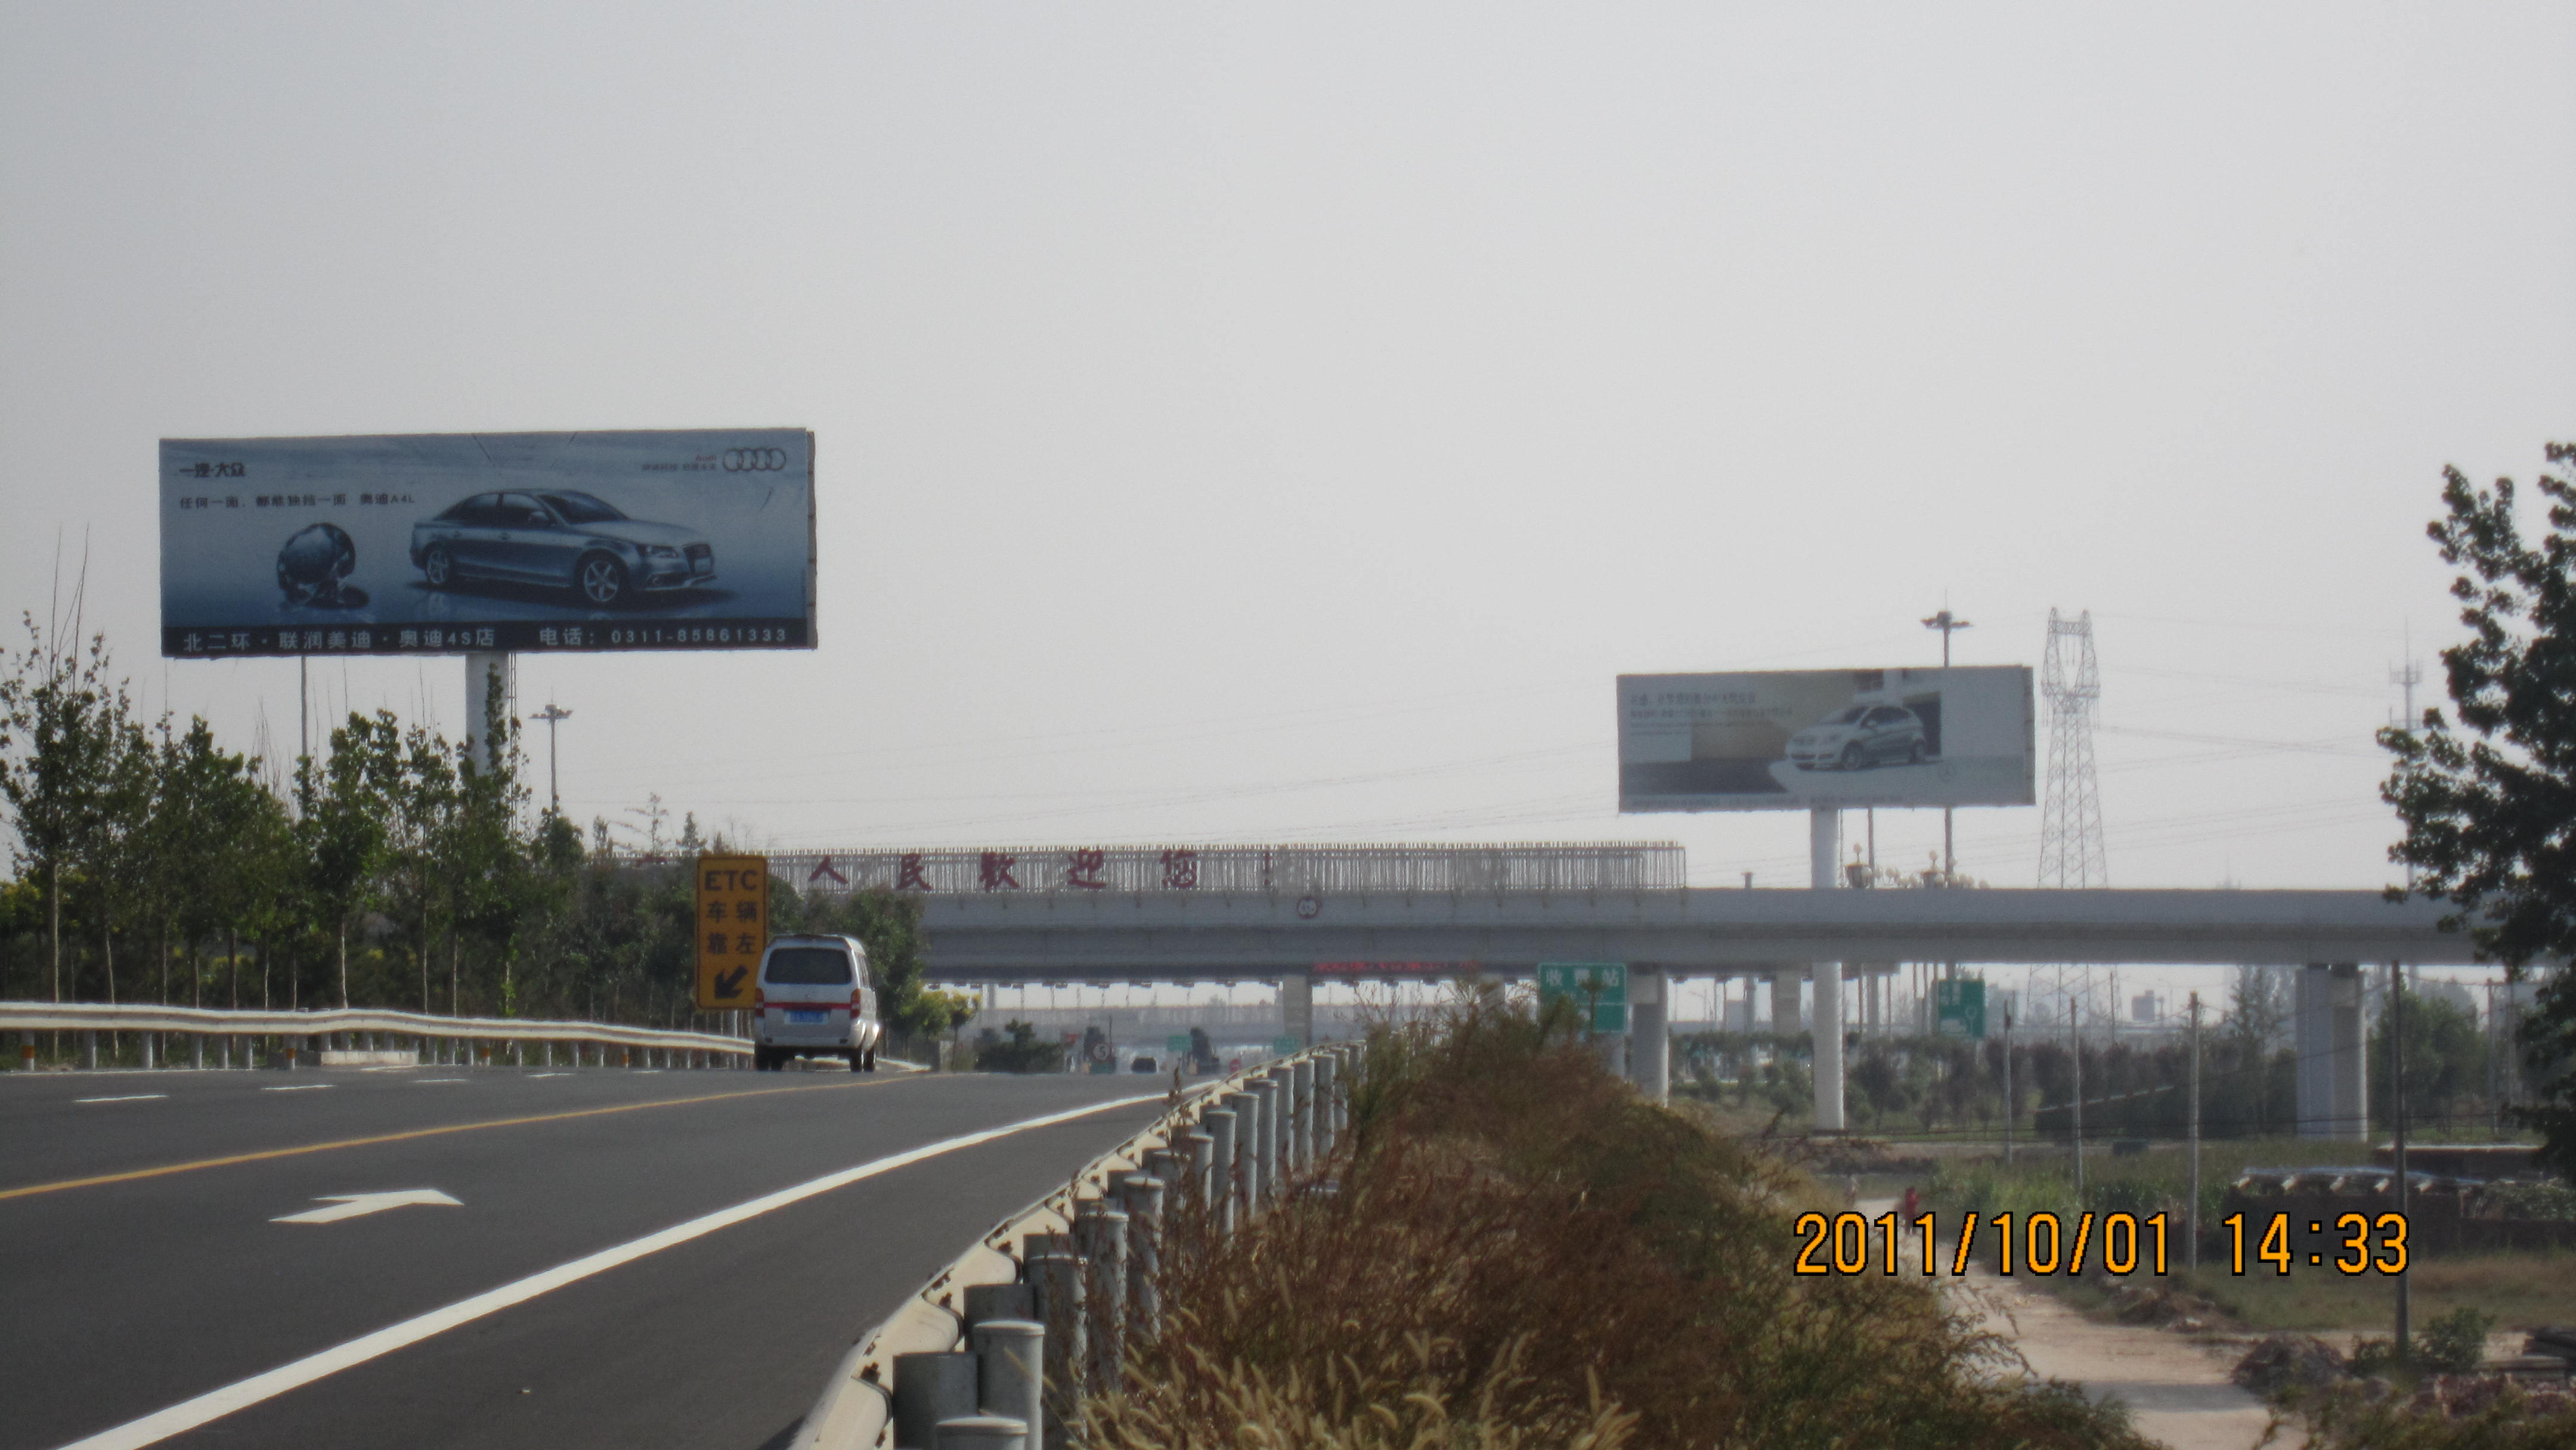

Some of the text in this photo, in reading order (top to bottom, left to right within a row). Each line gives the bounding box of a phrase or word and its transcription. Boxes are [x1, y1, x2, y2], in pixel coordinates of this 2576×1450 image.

[704, 869, 758, 891] ETC
[705, 900, 757, 923] 车辆
[706, 932, 756, 955] 靠左
